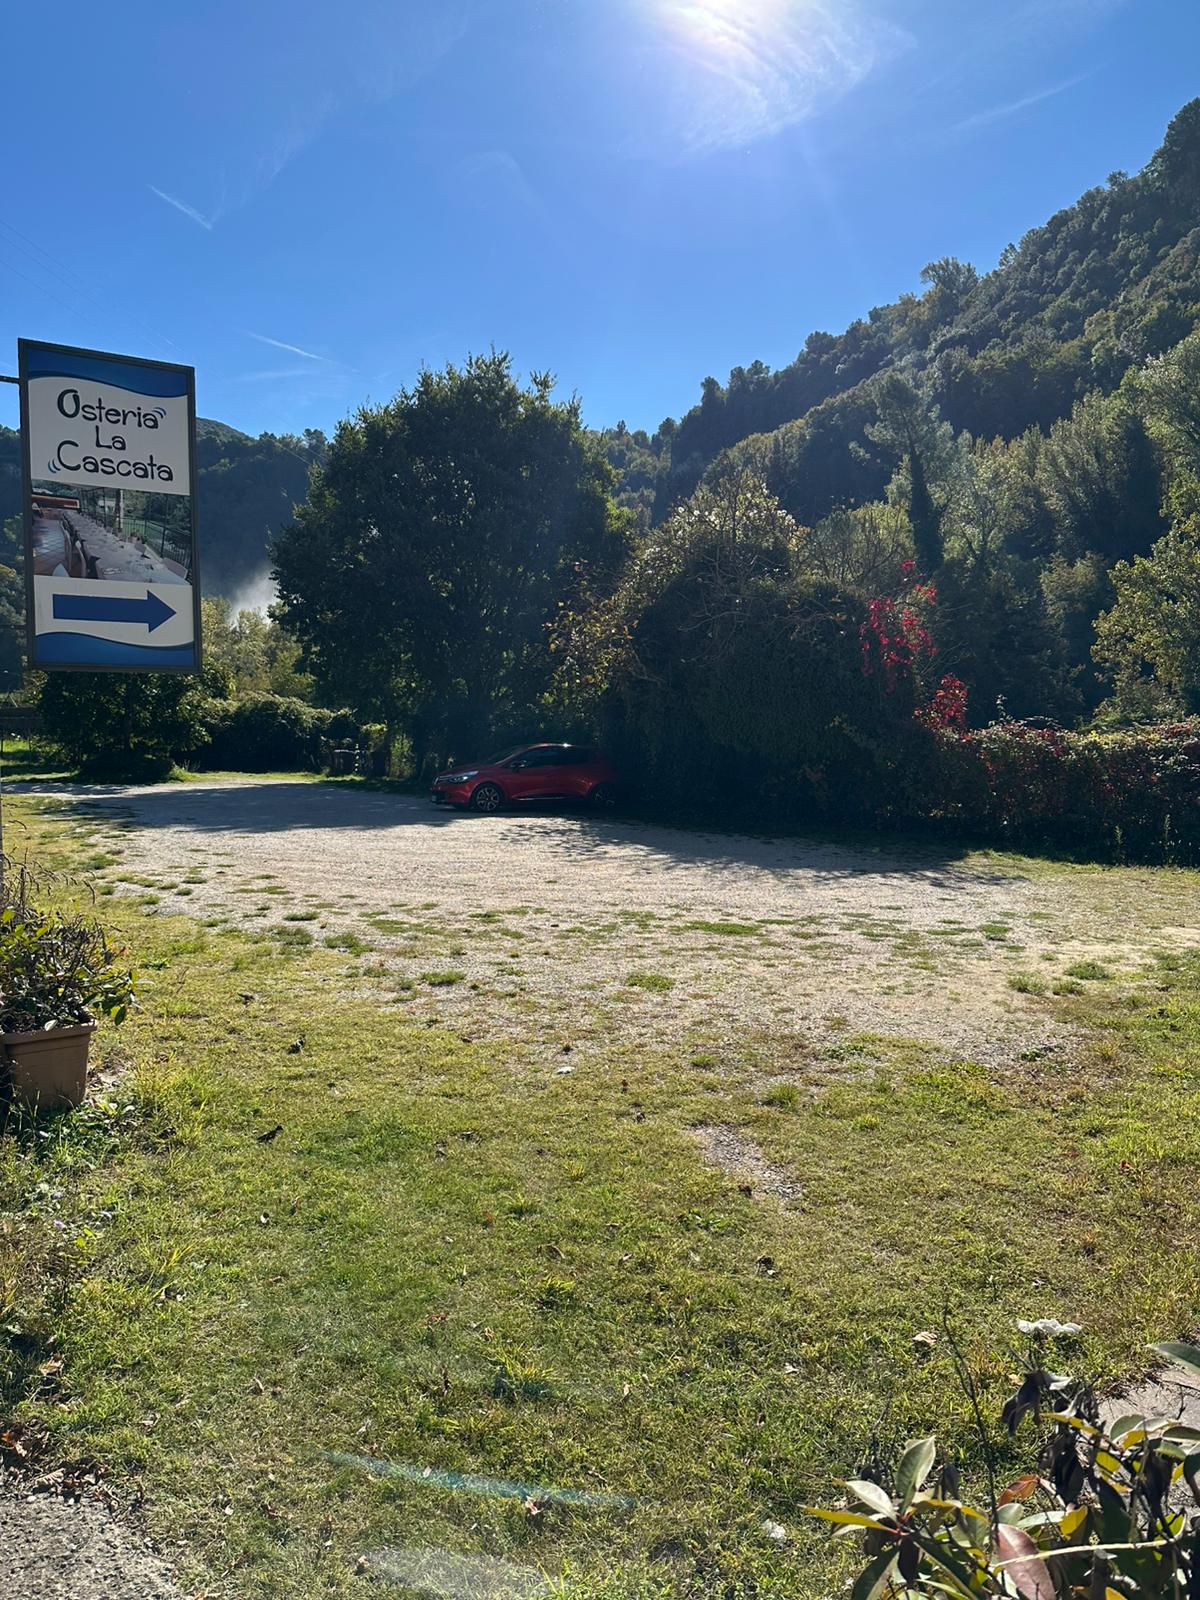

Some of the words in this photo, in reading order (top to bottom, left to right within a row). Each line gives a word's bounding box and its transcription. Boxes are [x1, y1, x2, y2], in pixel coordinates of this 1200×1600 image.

[57, 389, 159, 429] Osteria
[95, 425, 126, 451] La
[57, 440, 173, 482] Cascata
